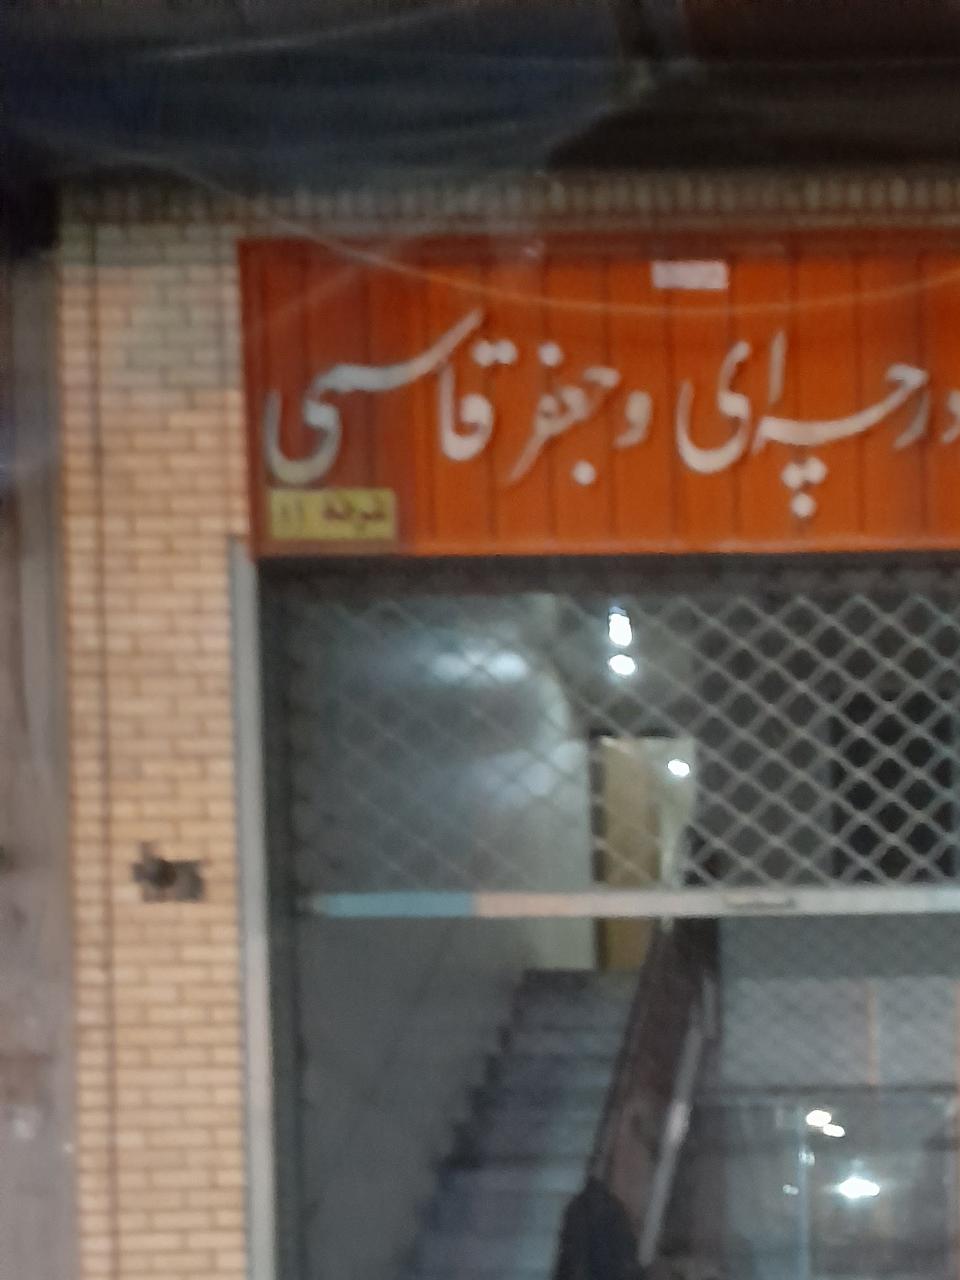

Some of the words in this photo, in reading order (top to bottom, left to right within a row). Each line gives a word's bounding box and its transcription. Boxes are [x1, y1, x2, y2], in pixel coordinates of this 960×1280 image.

[263, 306, 518, 485] قاسمی
[503, 341, 621, 487] جعفر
[613, 391, 653, 449] و
